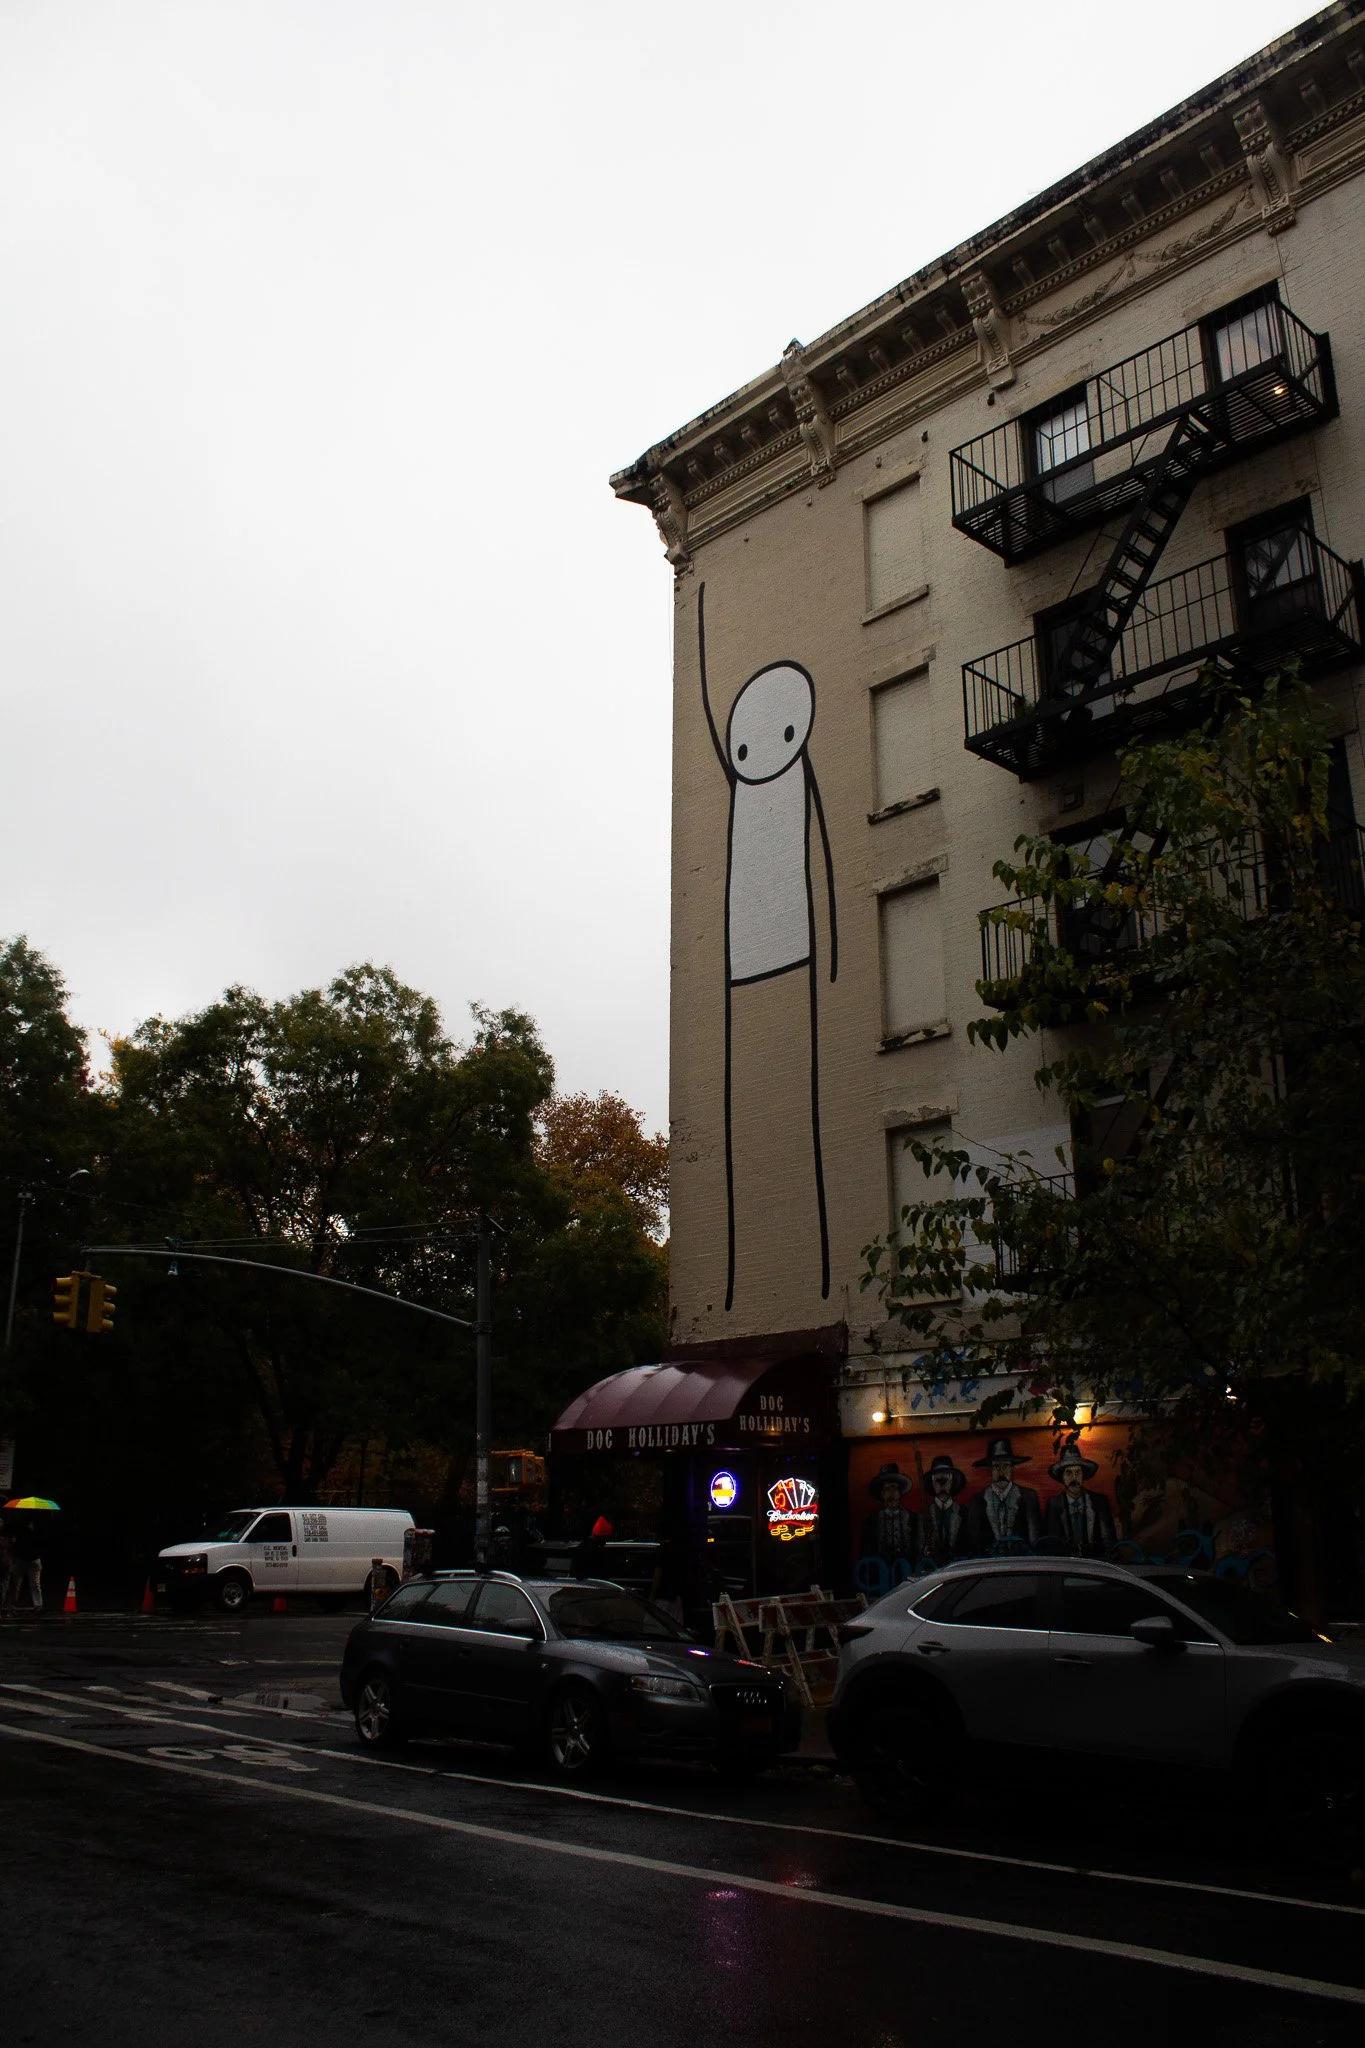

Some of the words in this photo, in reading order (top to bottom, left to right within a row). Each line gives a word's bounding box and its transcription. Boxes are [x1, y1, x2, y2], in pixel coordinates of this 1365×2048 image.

[760, 1395, 784, 1411] DOC
[739, 1415, 810, 1433] HOLLIDAY'S
[587, 1429, 613, 1450] DOC
[628, 1423, 716, 1449] HOLLIDAY'S
[767, 1510, 818, 1522] Budweiser
